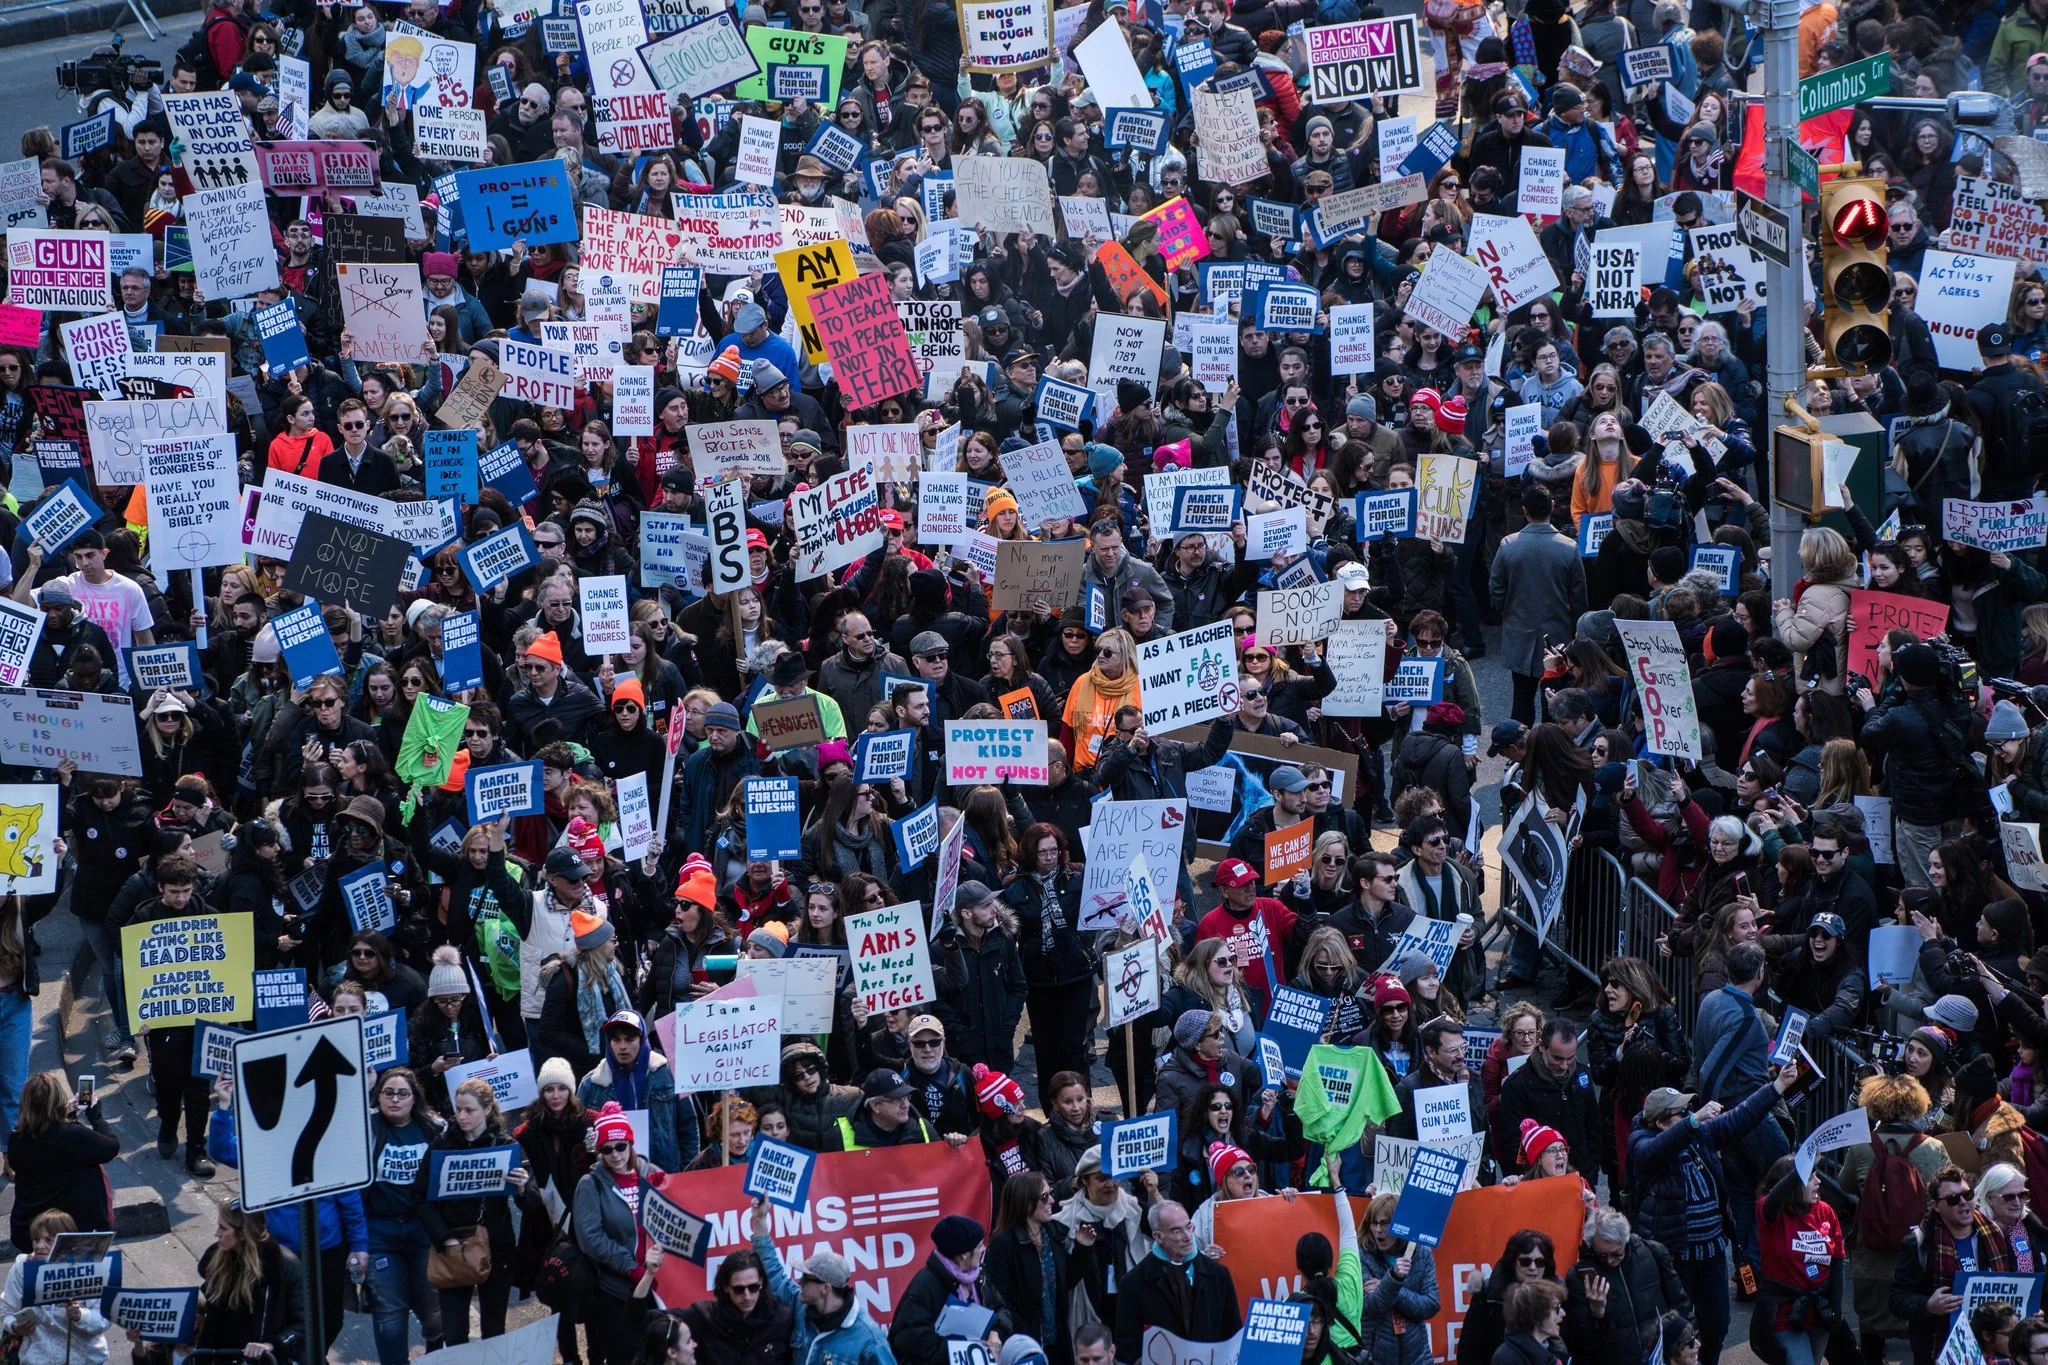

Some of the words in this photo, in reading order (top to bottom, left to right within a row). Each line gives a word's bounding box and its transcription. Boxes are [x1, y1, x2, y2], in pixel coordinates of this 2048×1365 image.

[977, 5, 1032, 20] ENOUGH
[1000, 19, 1013, 29] IS
[980, 27, 1033, 42] ENOUGH
[1311, 27, 1365, 49] BACK
[1312, 46, 1368, 63] GROUND
[1800, 70, 1866, 116] Columbus
[1872, 61, 1884, 80] Cir
[167, 100, 203, 113] FEAR
[206, 97, 232, 110] HAS
[594, 97, 609, 109] NO
[595, 107, 612, 122] MORE
[611, 93, 669, 121] SILENCE
[175, 114, 194, 126] NO
[197, 110, 242, 125] PLACE
[419, 105, 443, 119] ONE
[449, 110, 482, 121] PERSON
[190, 129, 205, 140] IN
[419, 126, 456, 141] EVERY
[459, 130, 480, 141] GUN
[615, 123, 672, 150] VIOLENCE
[192, 139, 253, 155] SCHOOLS
[420, 142, 480, 158] #ENOUGH
[1744, 210, 1761, 238] ONE
[1766, 222, 1783, 251] WAY
[39, 241, 102, 266] GUN
[1597, 248, 1634, 268] USA
[13, 272, 105, 286] VIOLENCE
[1597, 270, 1634, 289] NOT
[1929, 267, 1994, 282] ACTIVIST
[26, 290, 106, 306] CONTAGIOUS
[831, 275, 883, 306] WANT
[1938, 286, 1980, 298] AGREES
[1595, 291, 1637, 310] NRA
[821, 317, 843, 337] TO
[844, 297, 895, 328] TEACH
[1117, 327, 1143, 337] NOW
[830, 338, 852, 358] IN
[855, 326, 901, 353] PEACE
[1114, 340, 1124, 349] IS
[1127, 340, 1144, 350] NOT
[506, 348, 570, 374] PEOPLE
[838, 357, 870, 380] NOT
[879, 349, 898, 367] IN
[1109, 364, 1146, 375] REPEAL
[504, 376, 573, 407] PROFIT
[149, 452, 199, 465] MEMBERS
[204, 449, 223, 460] OF
[152, 482, 182, 494] HAVE
[192, 478, 215, 490] YOU
[714, 484, 730, 497] WE
[157, 491, 201, 505] REALLY
[709, 498, 738, 511] CALL
[1368, 500, 1401, 510] MARCH
[163, 505, 194, 518] READ
[198, 500, 230, 514] YOUR
[1949, 503, 2006, 518] LISTEN
[713, 512, 739, 545] B
[1369, 520, 1394, 530] LIVES
[1978, 516, 2018, 529] PUBLIC
[2021, 512, 2047, 529] POLL
[1950, 531, 1977, 545] GUN
[1981, 535, 2041, 549] CONTROL
[1977, 527, 2008, 540] WANT
[2018, 525, 2046, 538] MORE
[587, 589, 619, 600] CHANGE
[1271, 585, 1331, 613] BOOKS
[585, 600, 601, 611] GUN
[602, 599, 624, 610] LAWS
[1285, 606, 1321, 625] NOT
[590, 621, 621, 632] CHANGE
[586, 631, 626, 643] CONGRESS
[1143, 646, 1160, 660] AS
[1166, 641, 1175, 652] A
[1179, 625, 1233, 649] TEACHER
[1624, 632, 1652, 655] Stop
[1151, 669, 1181, 688] WANT
[1145, 712, 1167, 726] NOT
[1172, 710, 1181, 721] A
[1184, 698, 1219, 715] PIECE
[13, 712, 84, 730] ENOUGH
[760, 712, 818, 738] #ENOUGH
[33, 730, 51, 740] IS
[952, 728, 1034, 742] PROTECT
[978, 745, 1023, 758] KIDS
[952, 767, 987, 780] NOT
[747, 779, 788, 791] MARCH
[748, 802, 780, 814] LIVES
[1270, 846, 1286, 858] WE
[1285, 839, 1299, 854] CAN
[1298, 834, 1310, 846] END
[1270, 857, 1284, 869] GUN
[1285, 847, 1310, 864] VIOLENCE
[151, 919, 218, 935] CHILDREN
[852, 918, 871, 929] The
[877, 913, 900, 926] Only
[140, 934, 188, 950] ACTING
[193, 932, 223, 944] LIKE
[859, 930, 917, 957] ARMS
[139, 945, 226, 968] LEADERS
[859, 962, 878, 974] We
[883, 954, 914, 969] Need
[153, 971, 210, 985] LEADERS
[860, 978, 884, 992] Are
[891, 973, 913, 984] For
[141, 984, 188, 999] ACTING
[195, 982, 224, 994] LIKE
[865, 985, 924, 1013] HYGGE
[138, 996, 234, 1020] CHILDREN
[705, 1040, 752, 1053] AGAINST
[716, 1057, 744, 1067] GUN
[691, 1064, 770, 1084] VIOLENCE
[1425, 1100, 1461, 1113] CHANGE
[1421, 1115, 1438, 1127] GUN
[1440, 1112, 1466, 1126] LAWS
[1971, 1283, 2018, 1294] MARCH
[120, 1297, 172, 1310] MARCH
[1252, 1302, 1300, 1318] MARCH
[1247, 1328, 1283, 1343] LIVES
